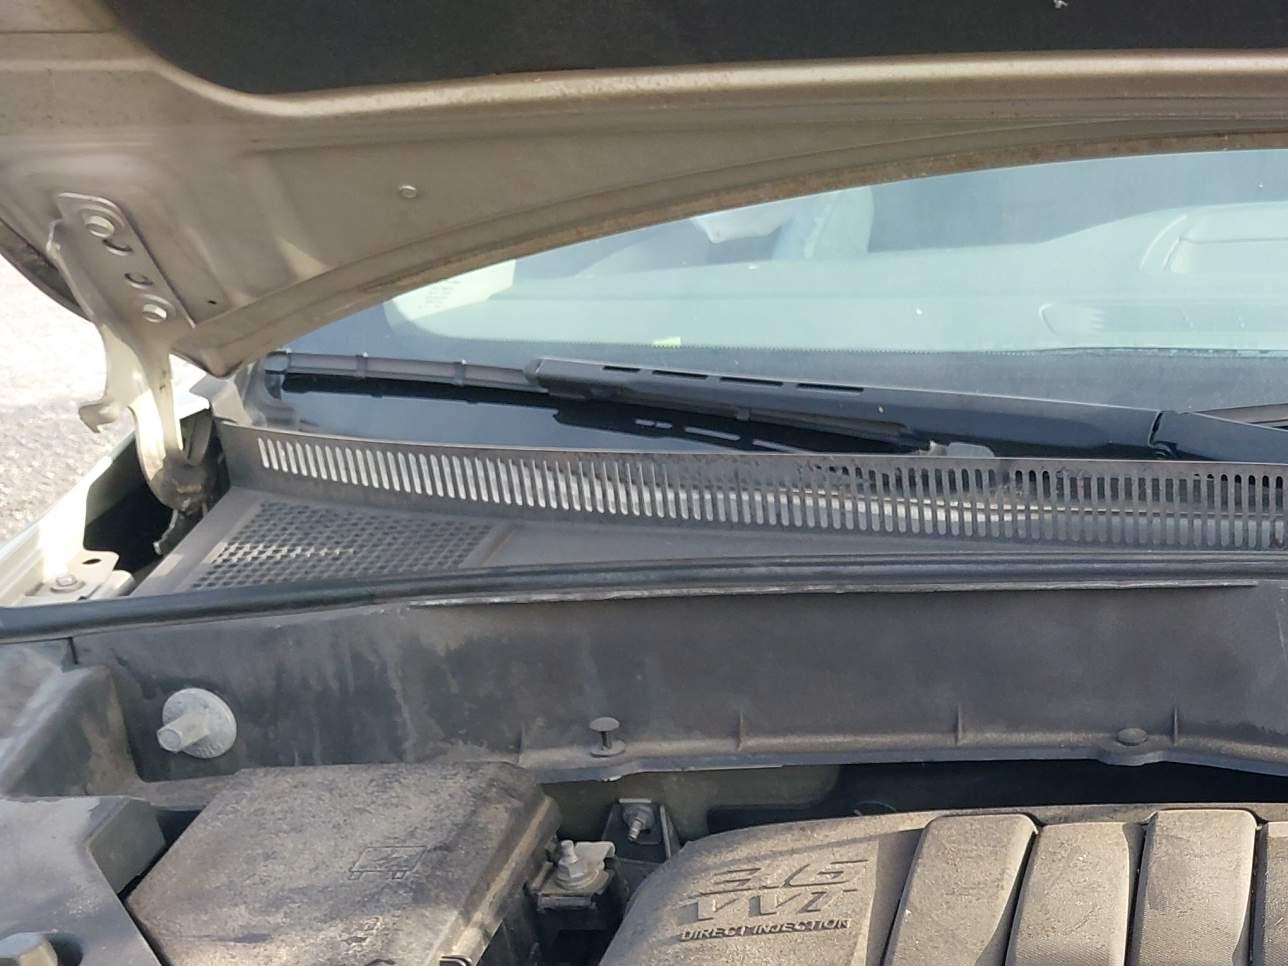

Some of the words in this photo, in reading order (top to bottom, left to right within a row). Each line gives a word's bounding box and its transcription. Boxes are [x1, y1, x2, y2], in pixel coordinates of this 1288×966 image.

[696, 859, 869, 897] 3.6
[681, 926, 748, 942] DIRECT
[752, 919, 852, 935] INJECTION
